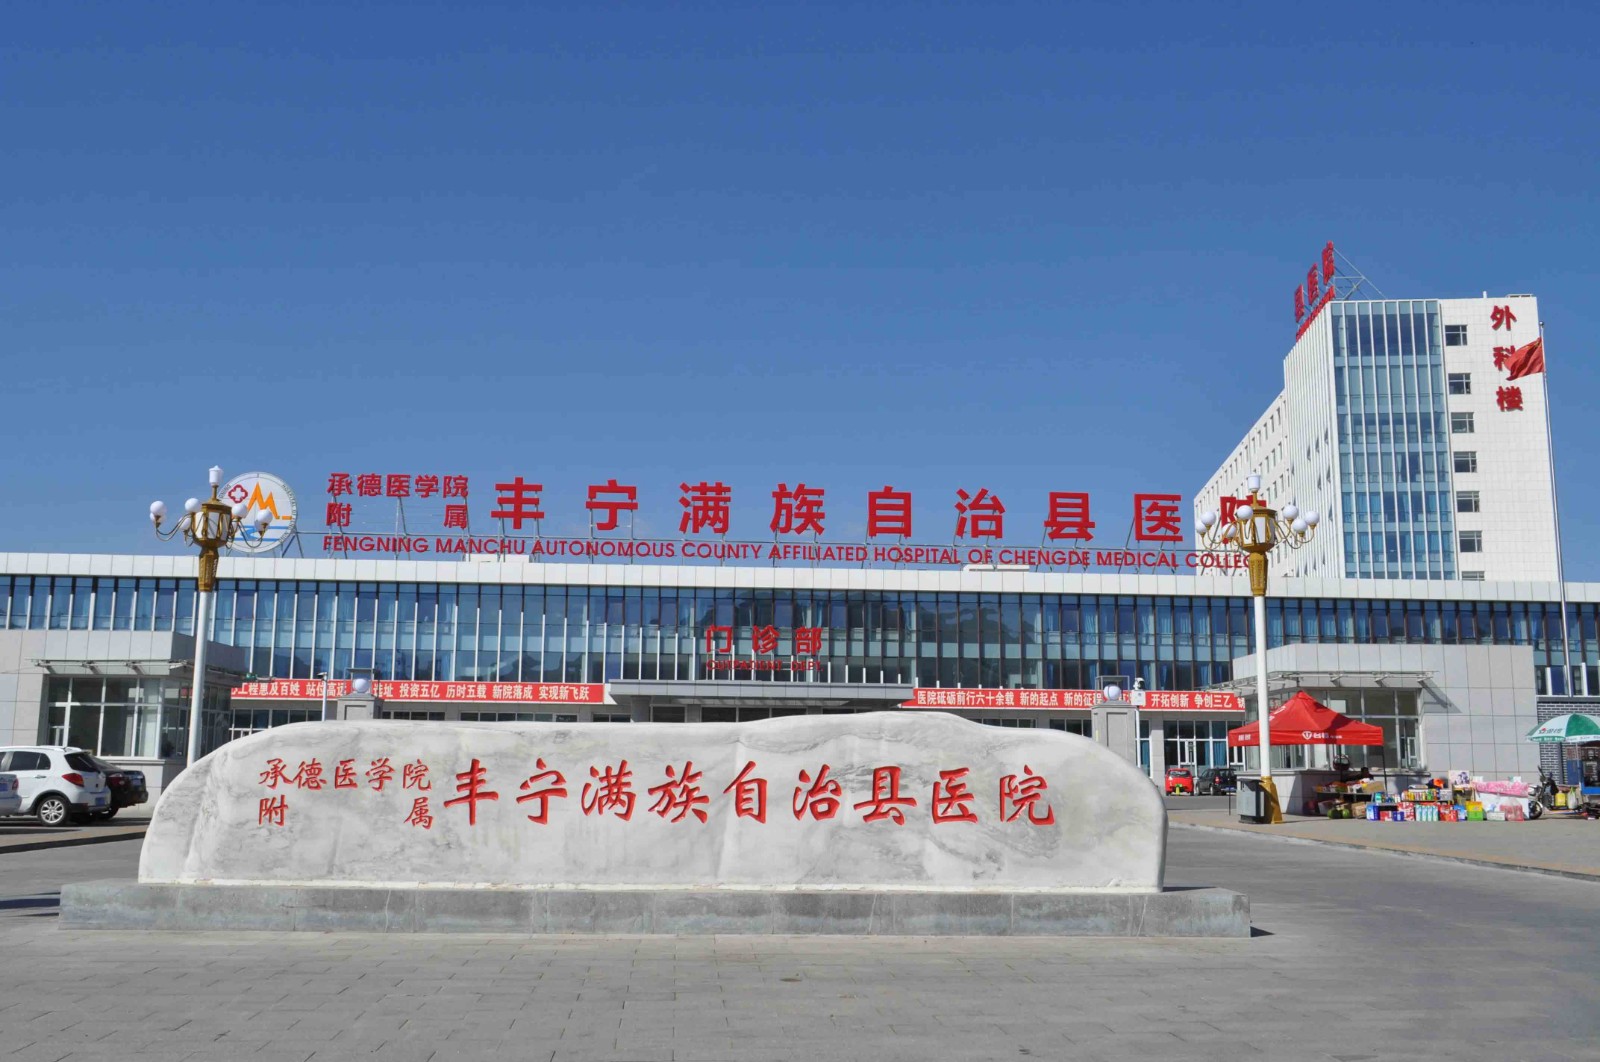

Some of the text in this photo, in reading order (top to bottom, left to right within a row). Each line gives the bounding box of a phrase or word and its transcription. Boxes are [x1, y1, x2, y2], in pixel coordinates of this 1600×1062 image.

[1490, 304, 1523, 411] 外科楼
[328, 473, 468, 498] 承德医学院
[323, 535, 429, 553] FENGNING
[436, 538, 525, 555] MANCHU
[532, 540, 675, 557] AUTONOMOUS
[681, 542, 763, 559] COUNTY
[768, 544, 867, 561] AFFILIATED
[874, 546, 961, 563] HOSPITAL
[967, 548, 993, 564] OF
[999, 549, 1090, 565] CHENGDE
[1096, 551, 1179, 567] MEDICAL
[705, 624, 823, 655] 门诊部
[707, 659, 781, 671] OUTPATIENT
[399, 683, 440, 698] 投资五亿
[445, 683, 487, 699] 历时五载
[492, 684, 533, 700] 新院落成
[538, 685, 590, 701] 实现新飞跃
[917, 690, 1014, 706] 医院砥砺前行六十余载
[1019, 691, 1059, 706] 新的起点
[1063, 692, 1103, 707] 新的征程
[1151, 693, 1190, 708] 开拓创新
[1194, 693, 1232, 708] 争创三乙
[259, 758, 432, 791] 承德医学院
[444, 758, 1056, 827] 丰宁满族自治县医院
